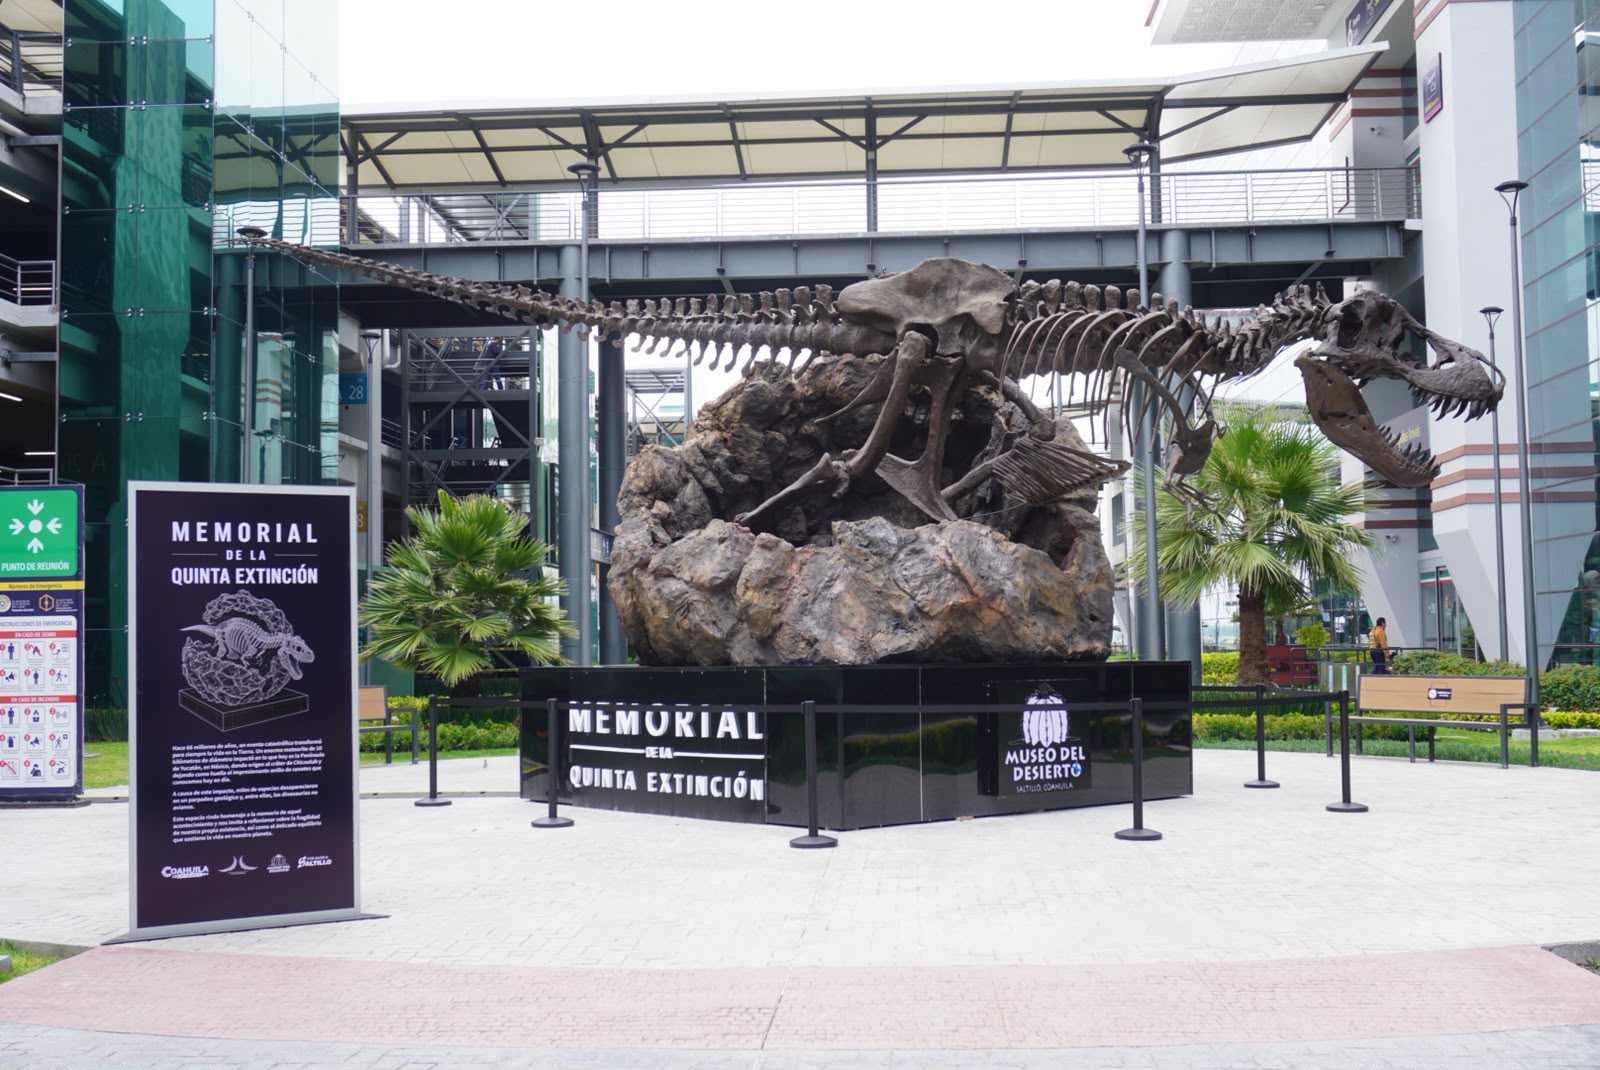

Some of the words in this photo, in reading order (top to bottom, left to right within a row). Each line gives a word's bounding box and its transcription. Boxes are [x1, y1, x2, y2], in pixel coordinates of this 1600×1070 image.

[348, 385, 364, 400] 28
[172, 521, 318, 543] MEMORIAL
[226, 550, 242, 560] DE
[250, 550, 266, 560] LA
[2, 562, 26, 571] PUNTO
[26, 562, 36, 571] DE
[37, 560, 70, 570] REUNIÓN
[172, 568, 230, 585] QUINTA
[236, 564, 318, 584] EXTINCIÓN
[569, 701, 763, 739] MEMORIAL
[645, 746, 658, 758] DE
[1005, 747, 1056, 765] MUSEO
[1060, 746, 1085, 761] DEL
[233, 768, 268, 776] impresionante
[1014, 762, 1082, 781] DESIERTO
[280, 783, 318, 791] desaparecieron
[569, 765, 637, 790] QUINTA
[647, 771, 764, 800] EXTINCIÓN
[1043, 782, 1073, 791] COAHUILA
[297, 820, 321, 828] equilibrio
[161, 866, 209, 878] COAHUILA
